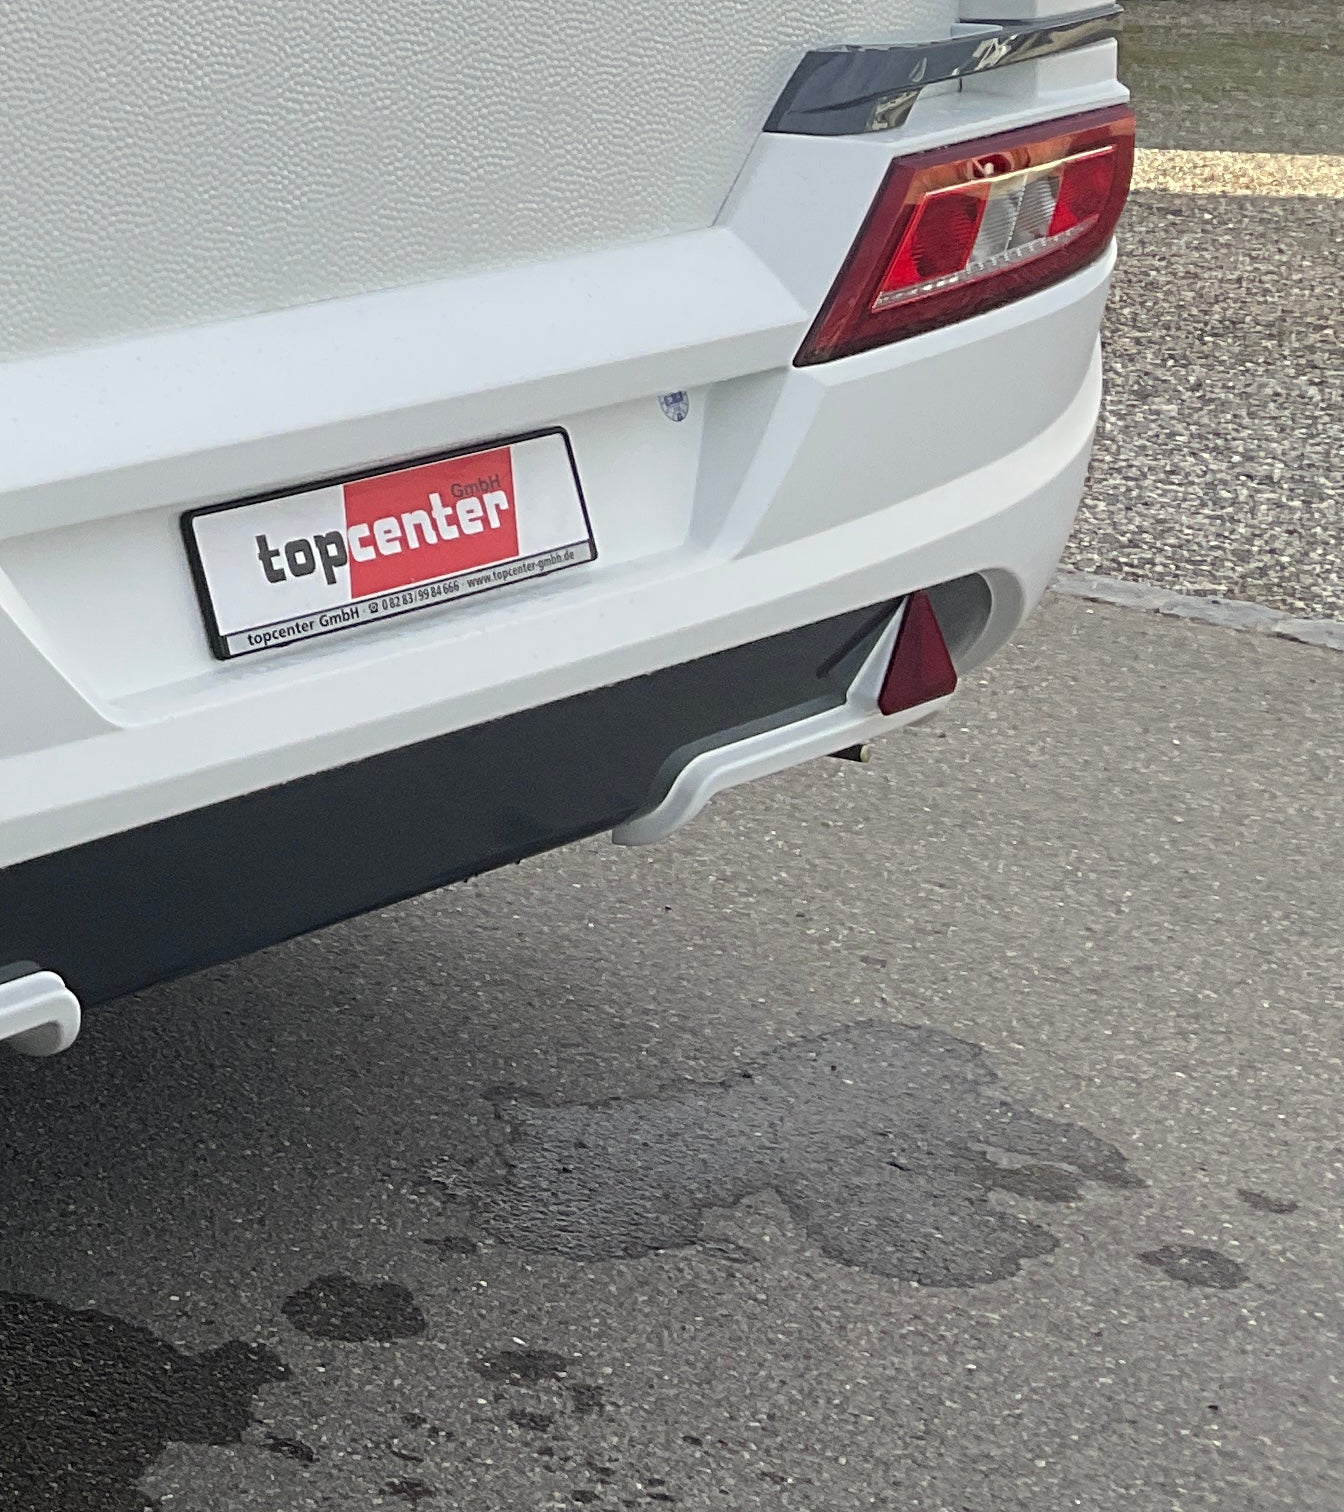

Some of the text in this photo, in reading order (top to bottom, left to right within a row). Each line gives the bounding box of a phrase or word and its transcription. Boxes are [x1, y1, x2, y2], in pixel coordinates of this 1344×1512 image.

[450, 474, 501, 498] GmbH
[255, 490, 509, 585] topcenter
[247, 619, 315, 646] topcenter
[319, 606, 360, 628] GmbH
[466, 549, 575, 588] www.topcenter-gmbh.de
